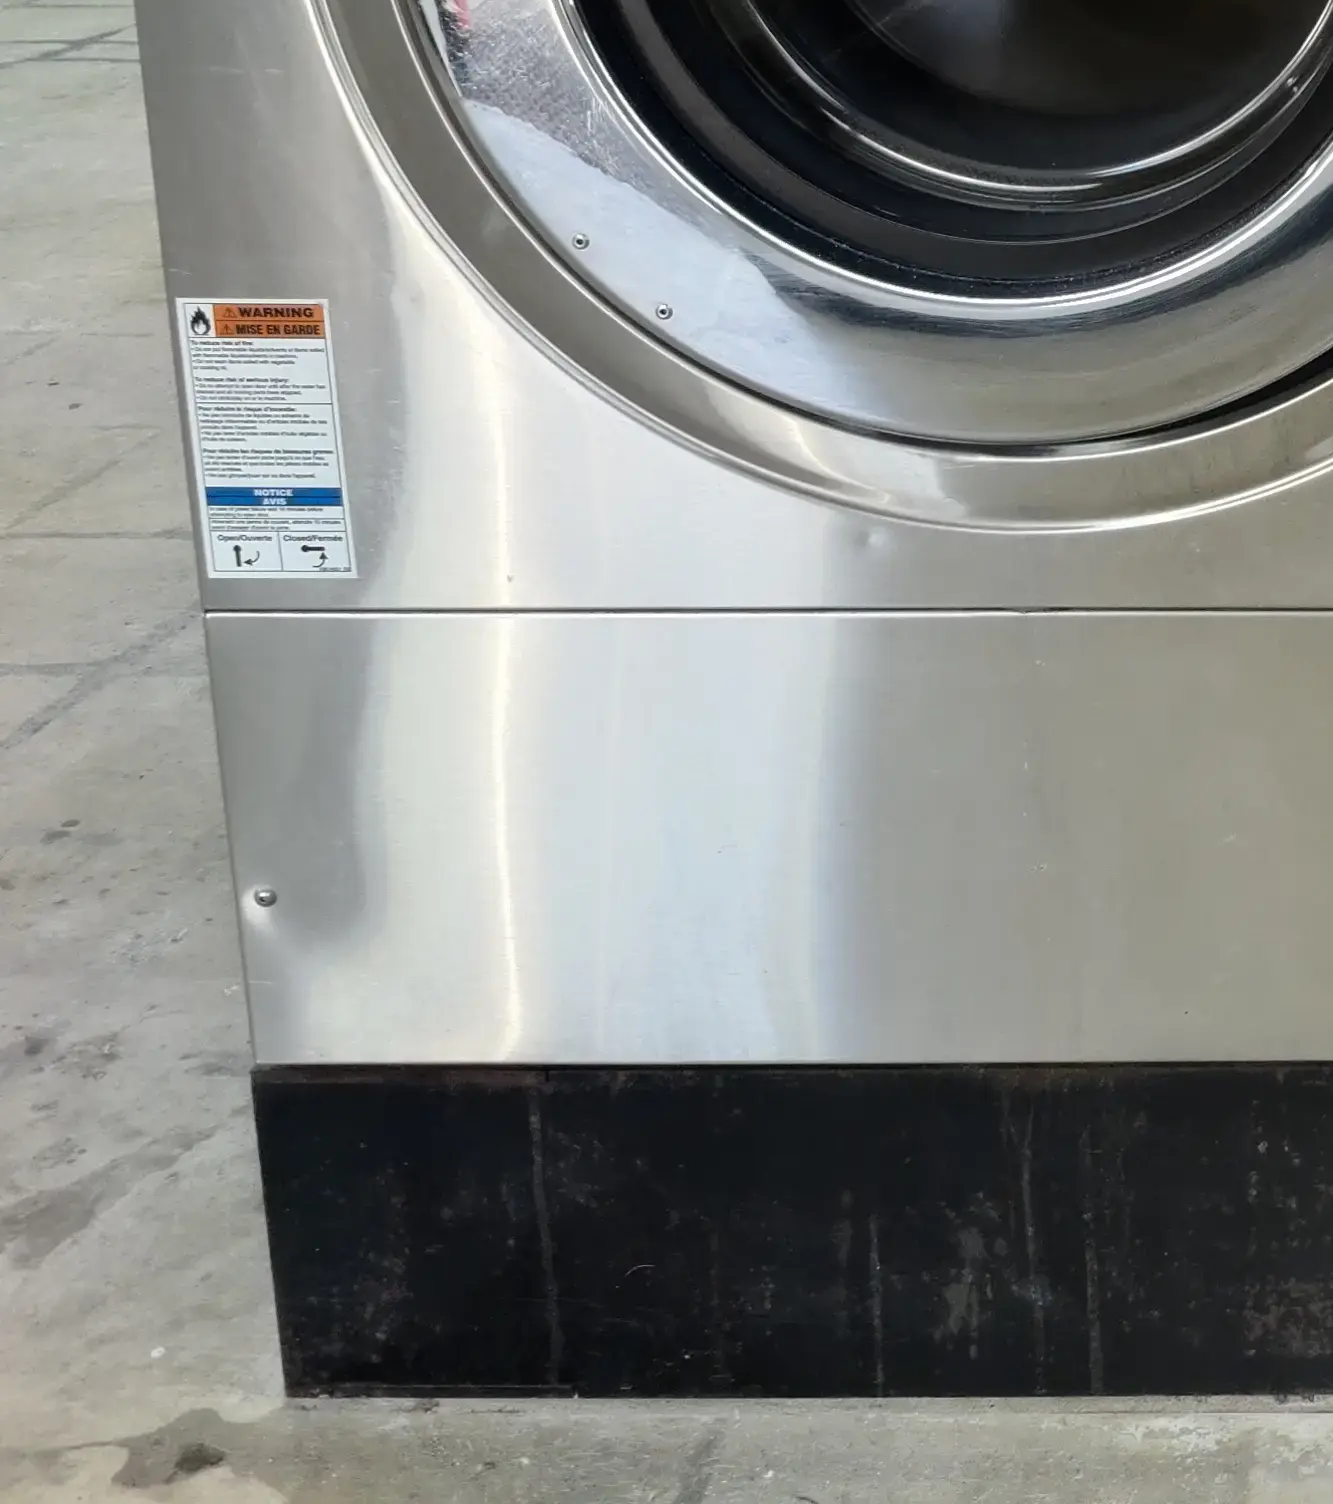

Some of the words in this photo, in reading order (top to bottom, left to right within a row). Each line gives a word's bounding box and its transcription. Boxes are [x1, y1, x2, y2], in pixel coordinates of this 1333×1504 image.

[238, 308, 314, 318] WARNING
[236, 324, 263, 335] MISE
[266, 324, 281, 335] EN
[284, 324, 320, 335] GARDE
